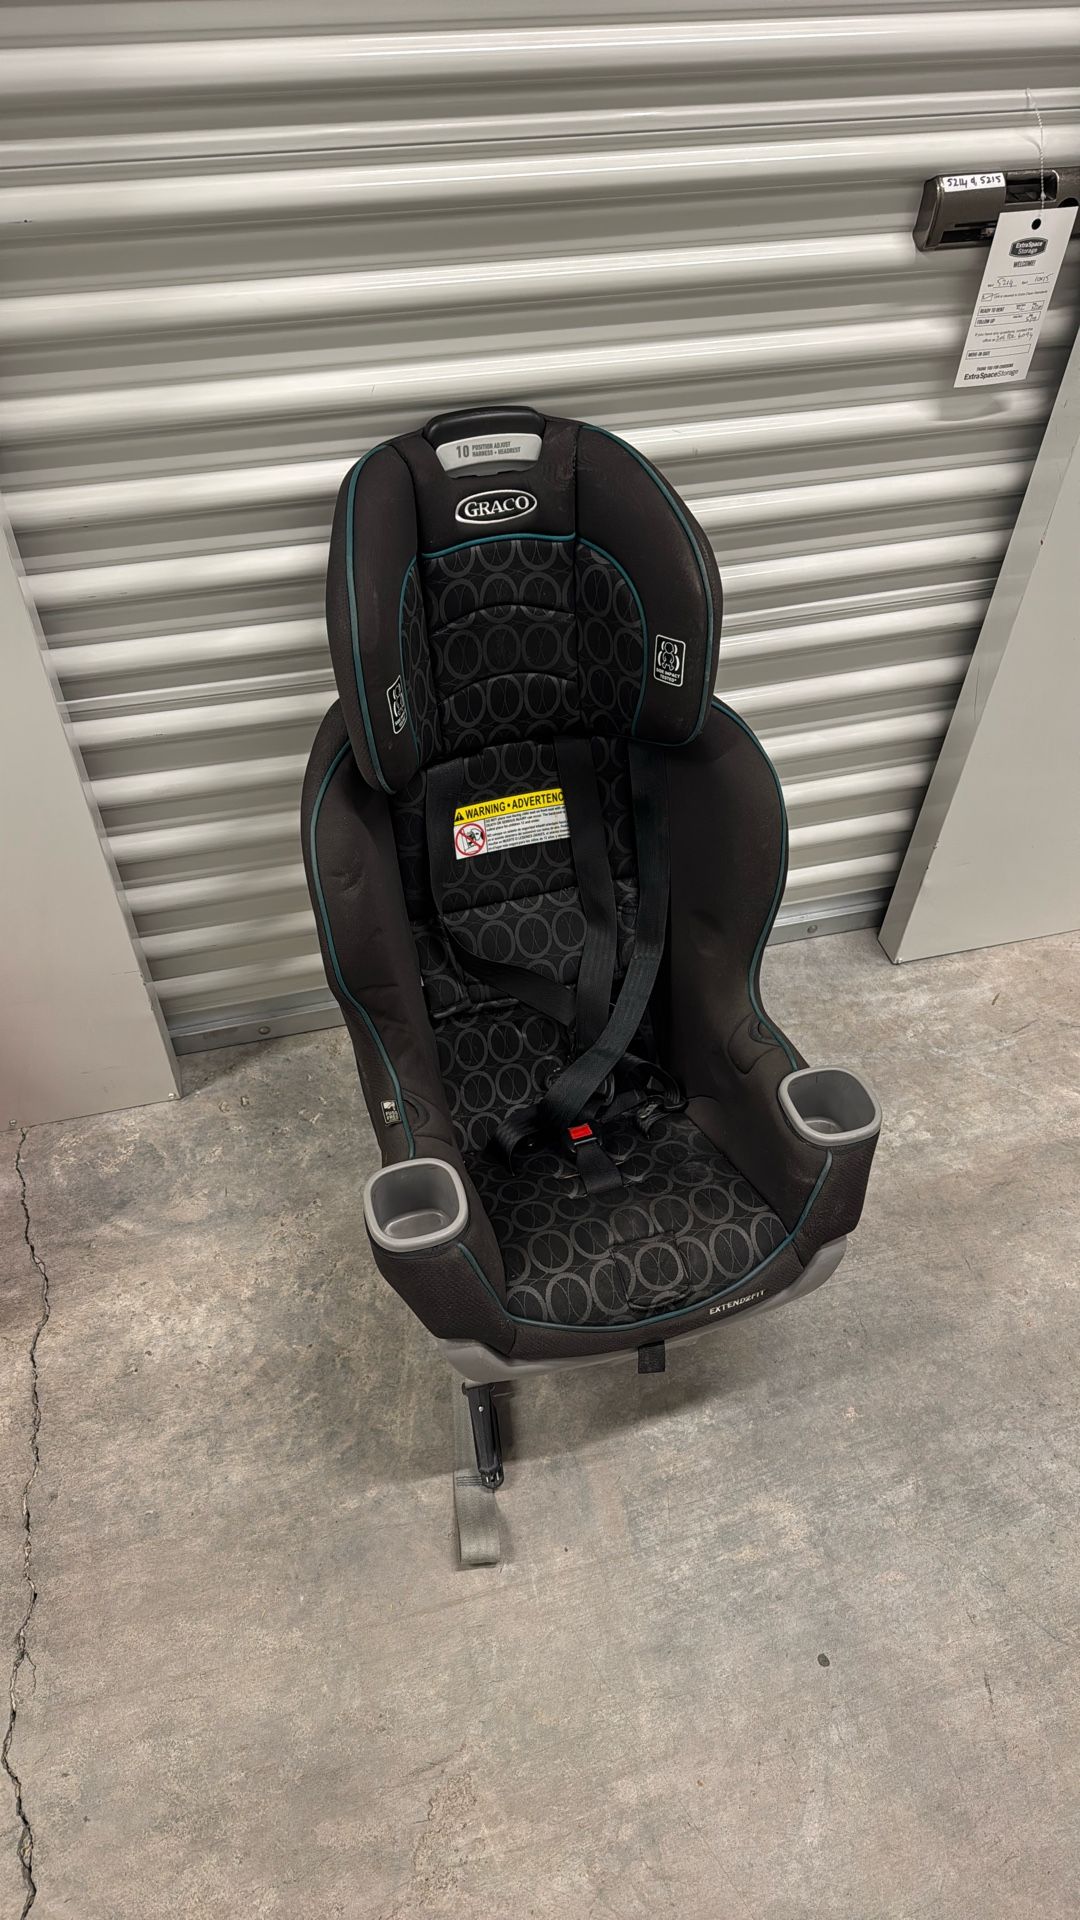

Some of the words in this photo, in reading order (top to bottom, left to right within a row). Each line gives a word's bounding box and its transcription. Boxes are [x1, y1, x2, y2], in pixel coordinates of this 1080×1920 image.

[947, 178, 968, 188] 5214
[980, 175, 1001, 184] 5215
[456, 445, 469, 458] 10
[498, 447, 521, 455] HEADREST
[464, 496, 529, 517] GRACO
[465, 802, 506, 820] WARNING
[709, 1289, 766, 1315] EXTEND2FIT
